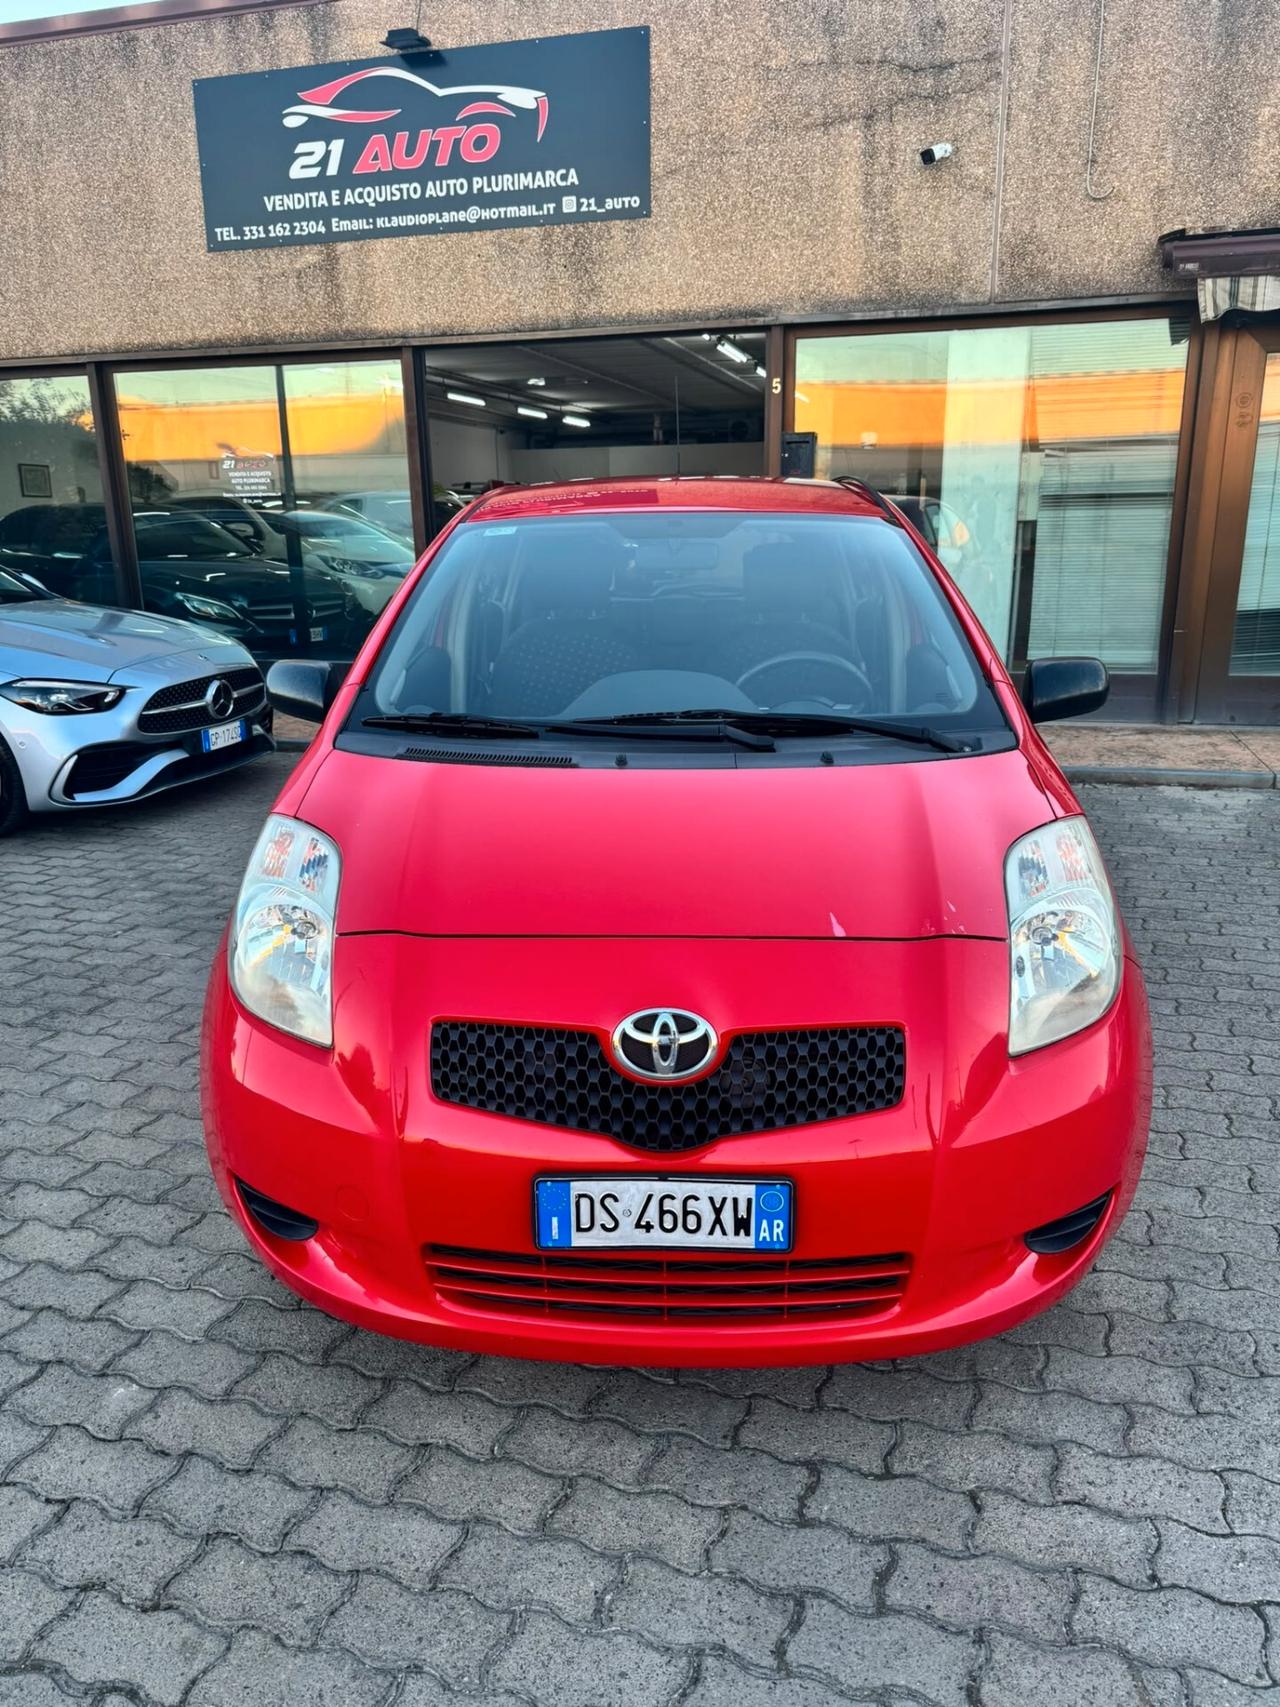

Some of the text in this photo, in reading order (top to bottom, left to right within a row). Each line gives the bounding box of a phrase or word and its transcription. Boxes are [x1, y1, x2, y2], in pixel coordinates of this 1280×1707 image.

[289, 123, 502, 180] 21 AUTO
[263, 168, 580, 212] VENDITA E ACQUISTO AUTO PLURIMARCA
[215, 227, 241, 242] TEL.
[243, 225, 266, 240] 331
[268, 223, 291, 238] 162
[294, 219, 326, 236] 2304
[772, 377, 781, 394] 5
[575, 1192, 753, 1238] DS 466XW
[758, 1219, 785, 1242] AR
